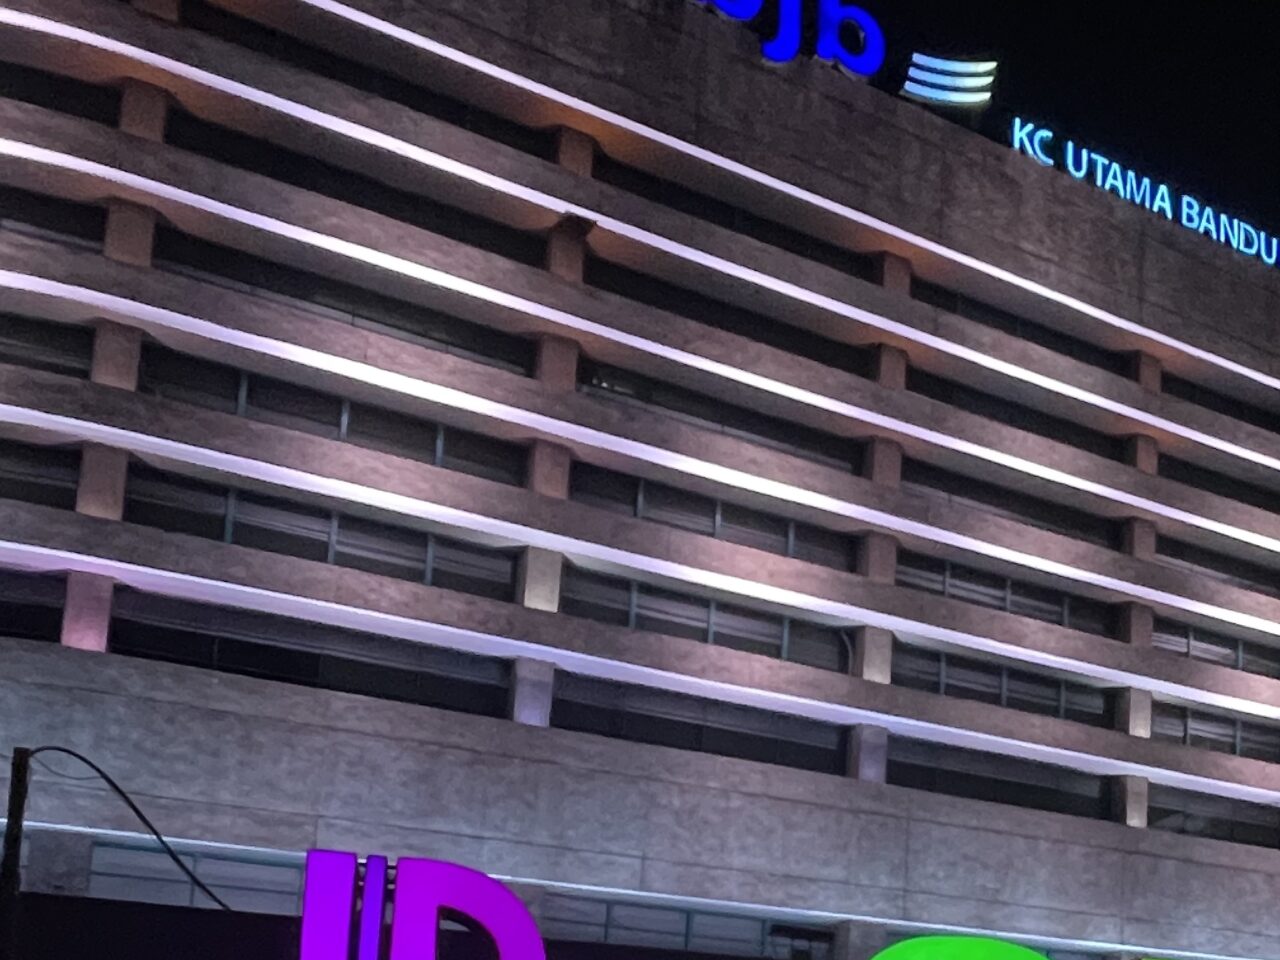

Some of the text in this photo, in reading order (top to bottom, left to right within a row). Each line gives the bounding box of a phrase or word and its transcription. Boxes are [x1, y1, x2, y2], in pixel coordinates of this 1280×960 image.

[711, 0, 886, 77] jb
[1012, 116, 1055, 167] KC
[1066, 140, 1173, 221] UTAMA
